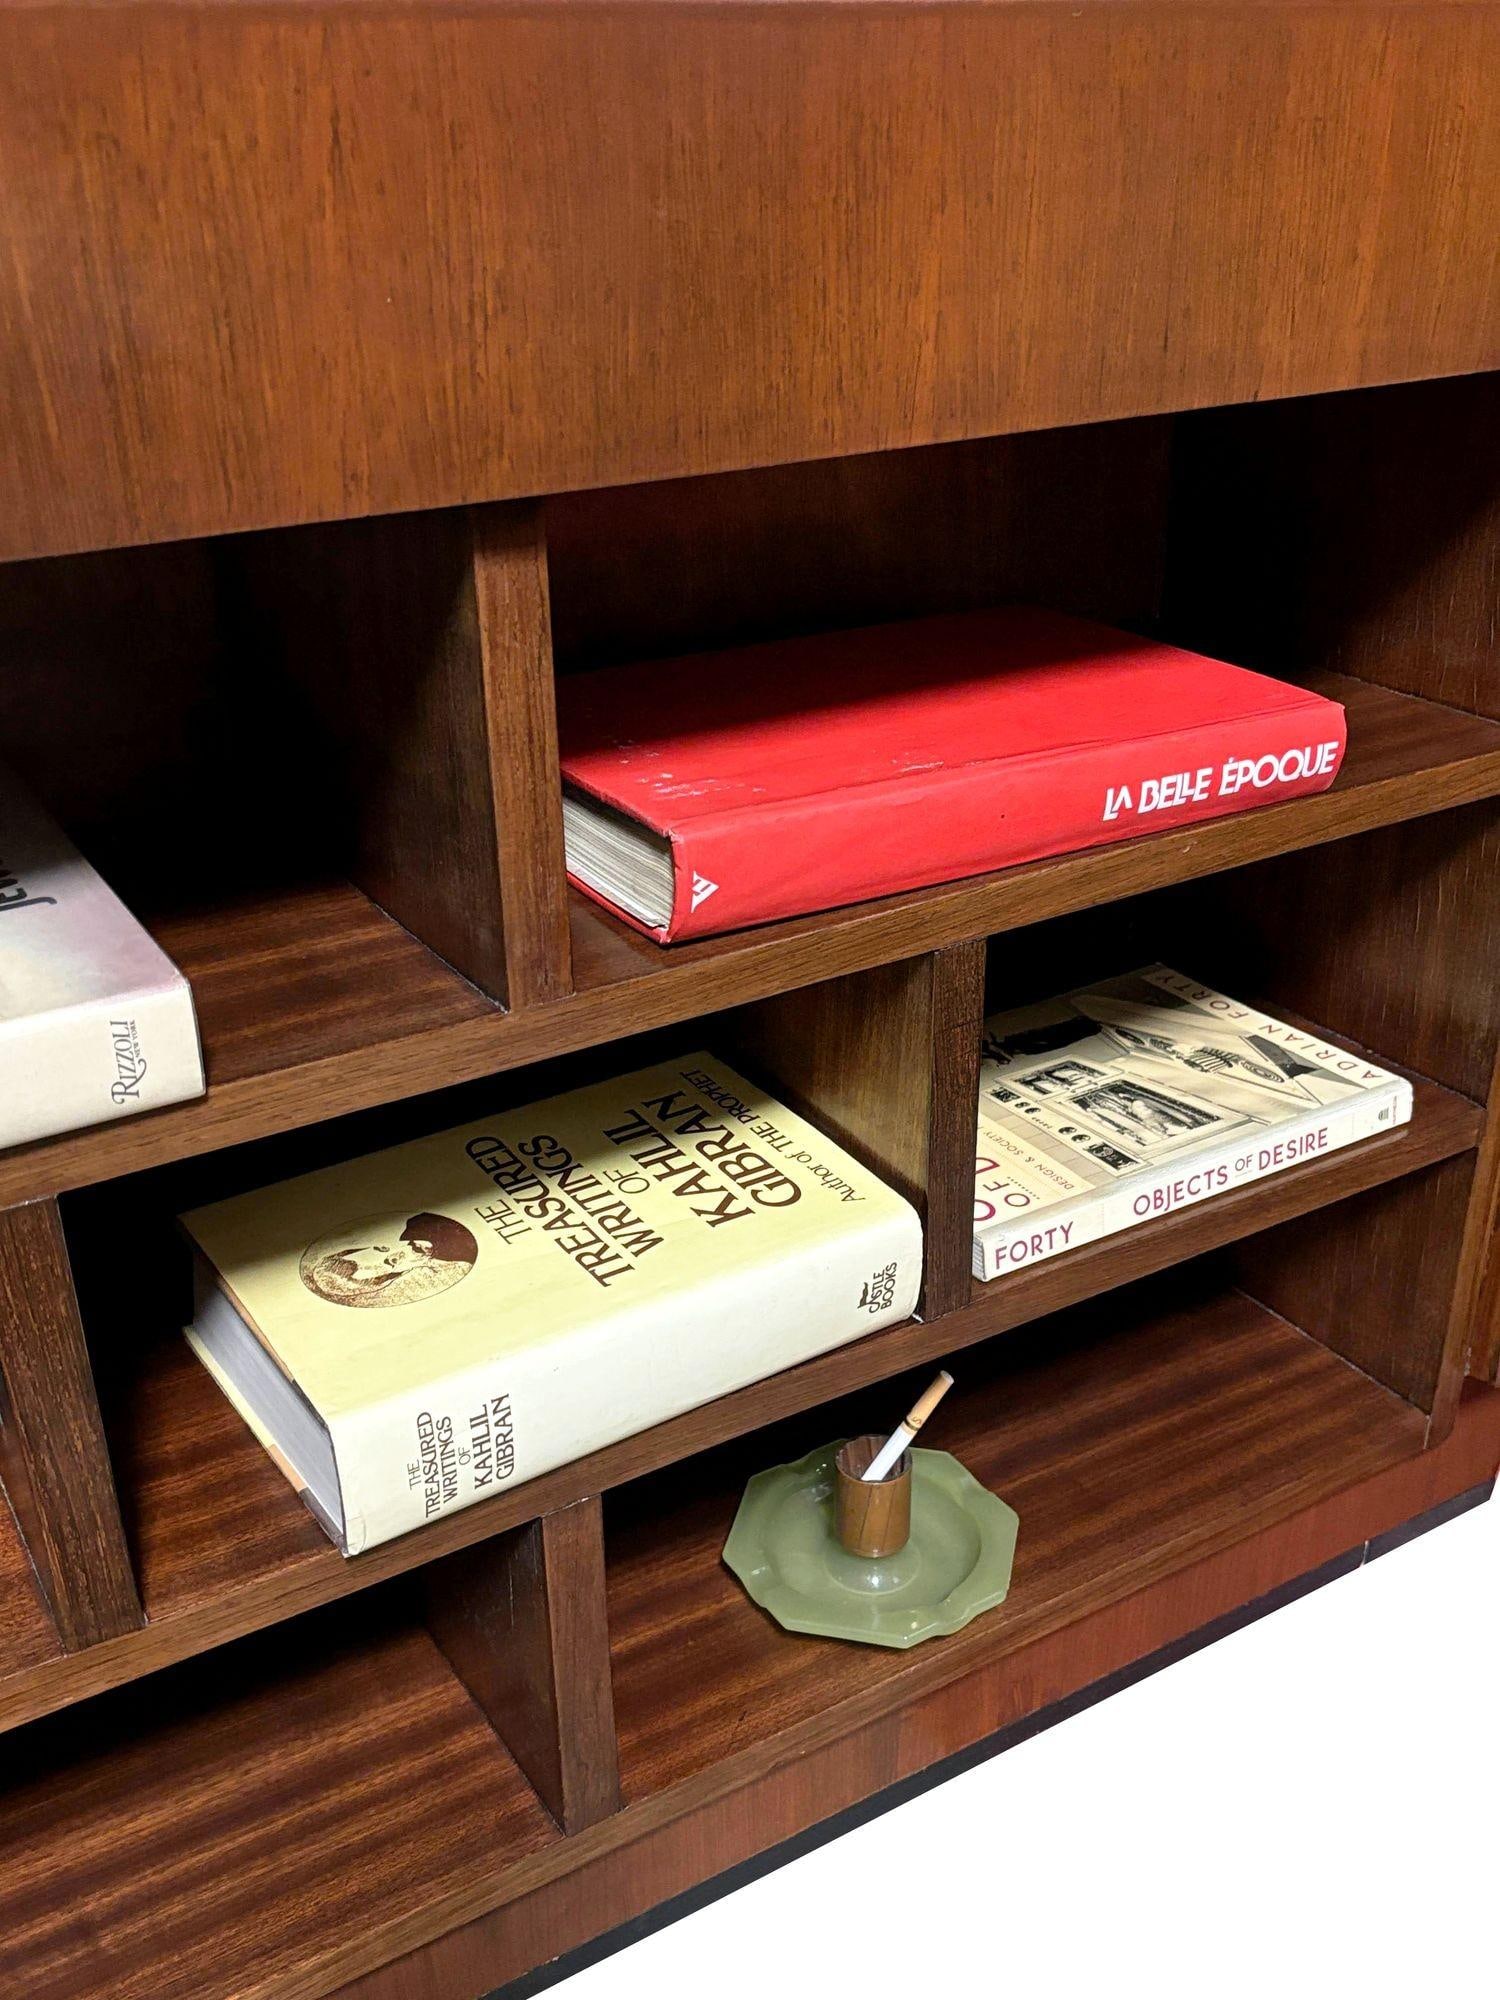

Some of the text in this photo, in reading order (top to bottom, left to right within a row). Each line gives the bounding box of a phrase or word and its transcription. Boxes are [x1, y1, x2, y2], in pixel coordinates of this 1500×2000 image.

[1103, 741, 1339, 821] LA BELLE ÉPOQUE
[110, 1020, 147, 1105] RIZZOLI
[1156, 976, 1383, 1080] ADRIAN FORTY
[602, 1108, 756, 1228] KAHLIL
[642, 1089, 801, 1207] GIBRAN
[679, 1070, 866, 1202] Author of THE PROPHET
[983, 1130, 1075, 1190] DESIGN & SOCIETY
[1133, 1127, 1329, 1217] OBJECTS OF DESIRE
[464, 1136, 635, 1287] TREASURED
[475, 1197, 525, 1245] THE
[518, 1135, 665, 1257] WRITINGS
[602, 1168, 651, 1195] OF
[982, 1180, 1031, 1208] OF
[881, 1262, 897, 1310] BOOKS
[995, 1221, 1074, 1270] FORTY
[407, 1459, 421, 1490] THE
[417, 1412, 441, 1518] TREASURED
[436, 1416, 458, 1503] WRITINGS
[457, 1447, 472, 1466] OF
[469, 1404, 493, 1489] KAHLIL
[491, 1393, 514, 1480] GIBRAN
